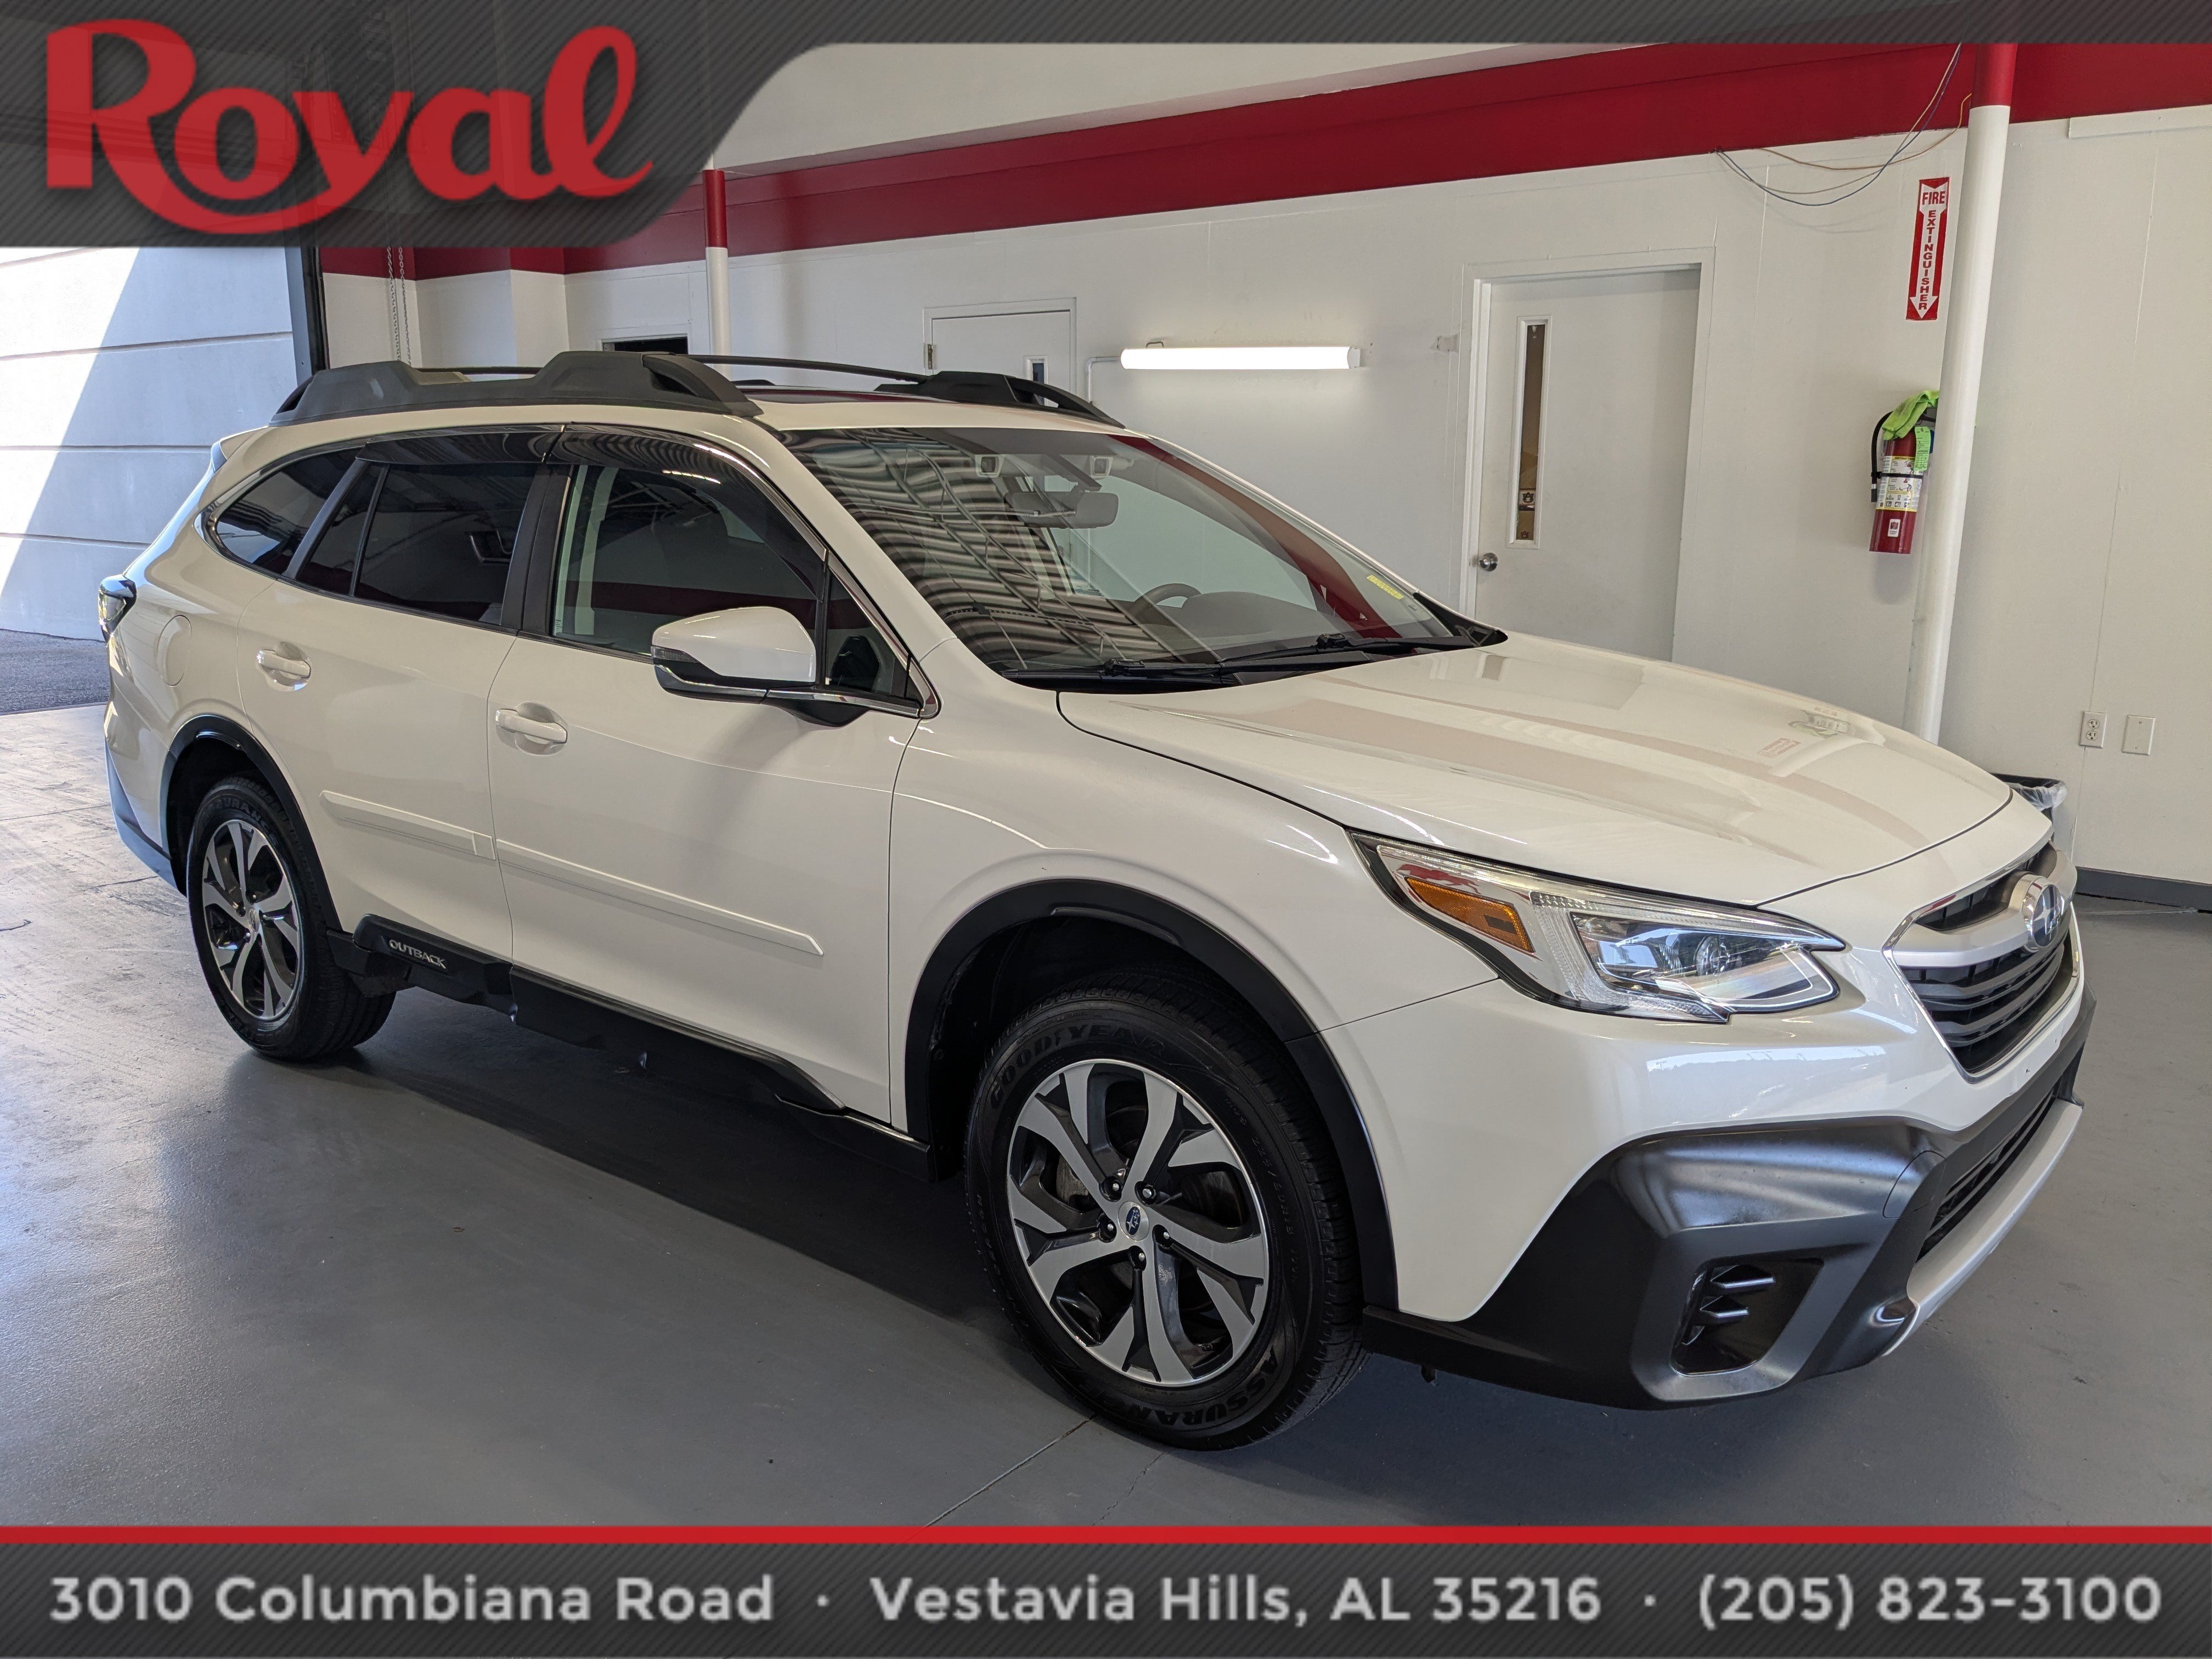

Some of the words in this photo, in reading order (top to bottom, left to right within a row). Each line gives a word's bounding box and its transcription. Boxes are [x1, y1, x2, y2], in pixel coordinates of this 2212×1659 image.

[1922, 190, 1946, 205] FIRE
[1918, 210, 1937, 311] EXTINGUISHER
[389, 939, 446, 969] OUTBACK
